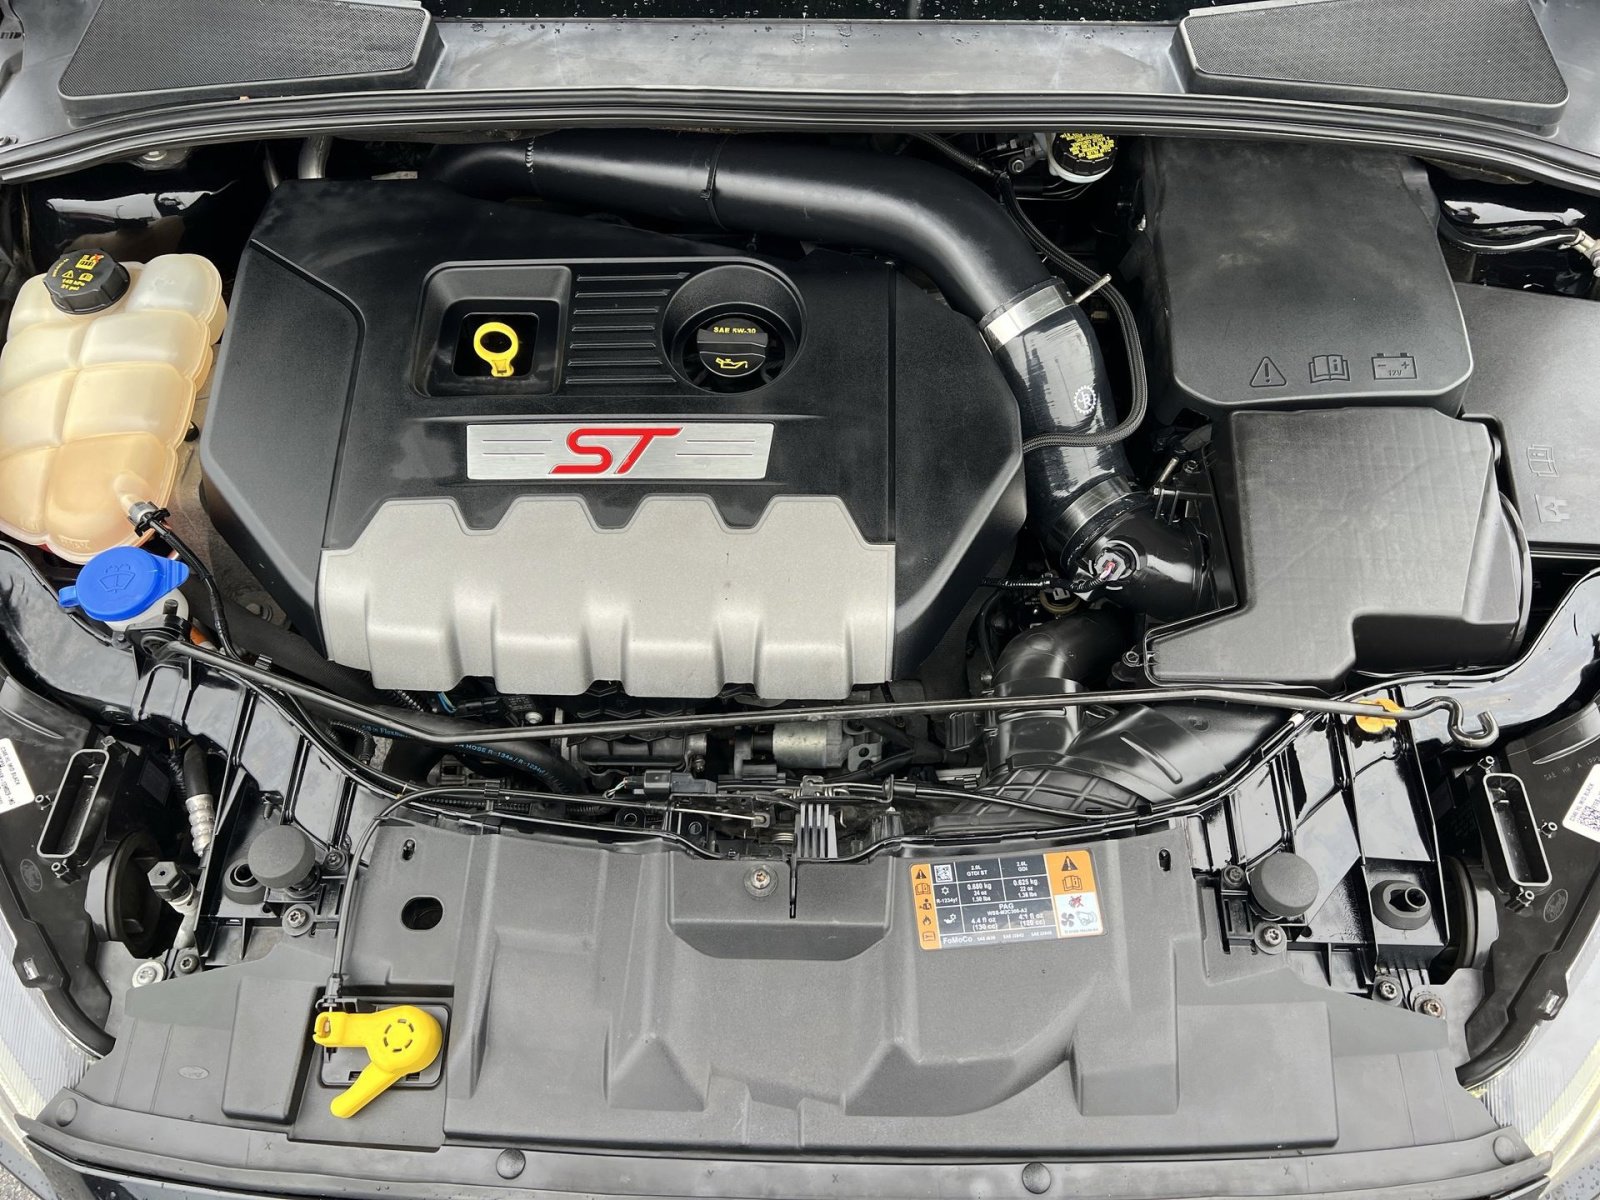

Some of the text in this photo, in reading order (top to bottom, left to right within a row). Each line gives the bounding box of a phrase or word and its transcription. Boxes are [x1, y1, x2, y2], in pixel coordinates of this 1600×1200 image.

[713, 326, 731, 334] SAE
[1388, 369, 1403, 377] 12V
[548, 427, 684, 475] ST
[466, 743, 487, 753] HOSE
[984, 882, 992, 890] kg
[1030, 878, 1038, 886] kg
[998, 902, 1014, 910] PAG
[942, 935, 973, 944] FoMoCo
